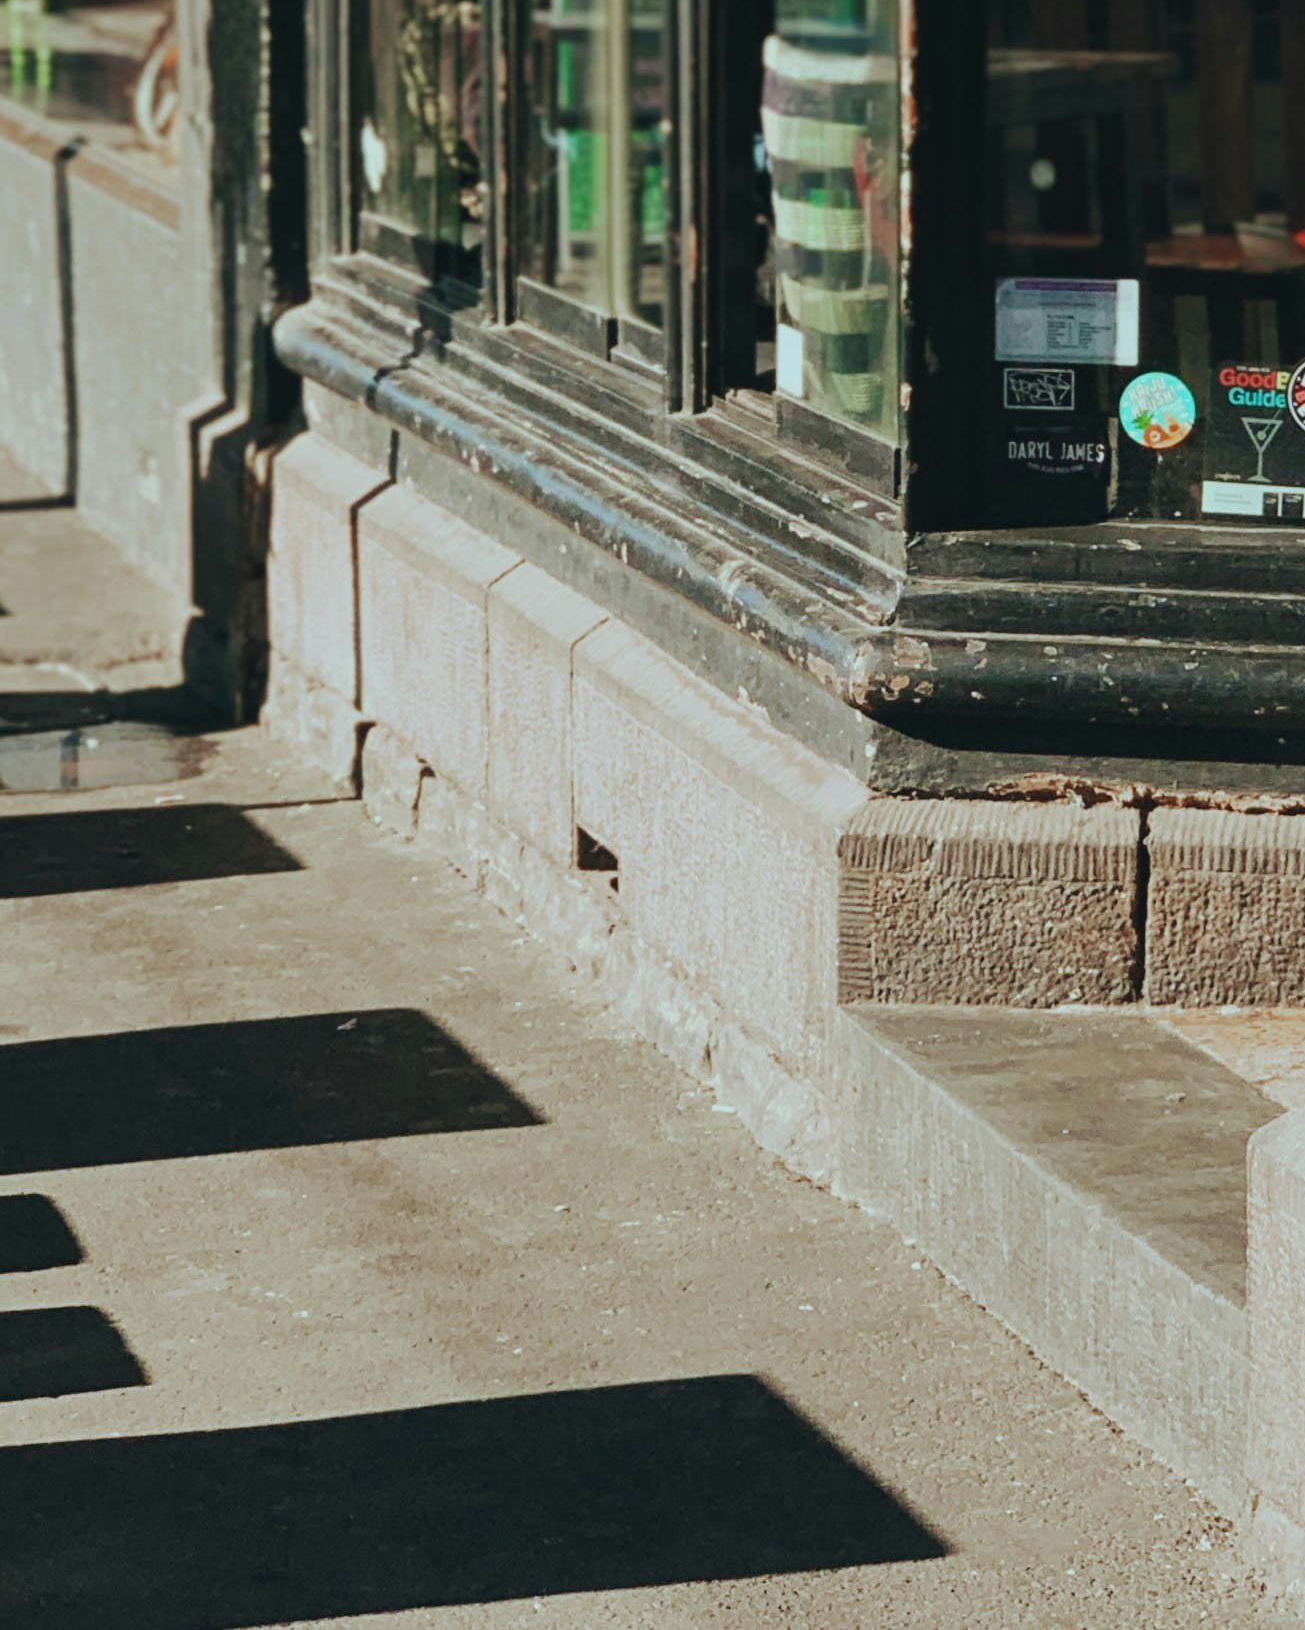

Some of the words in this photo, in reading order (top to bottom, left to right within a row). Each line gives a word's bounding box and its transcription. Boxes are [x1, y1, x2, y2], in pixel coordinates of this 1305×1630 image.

[1128, 377, 1166, 401] KAIJU
[1228, 387, 1287, 408] Guide
[1008, 441, 1053, 460] DARYL
[1061, 442, 1105, 463] JAMES
